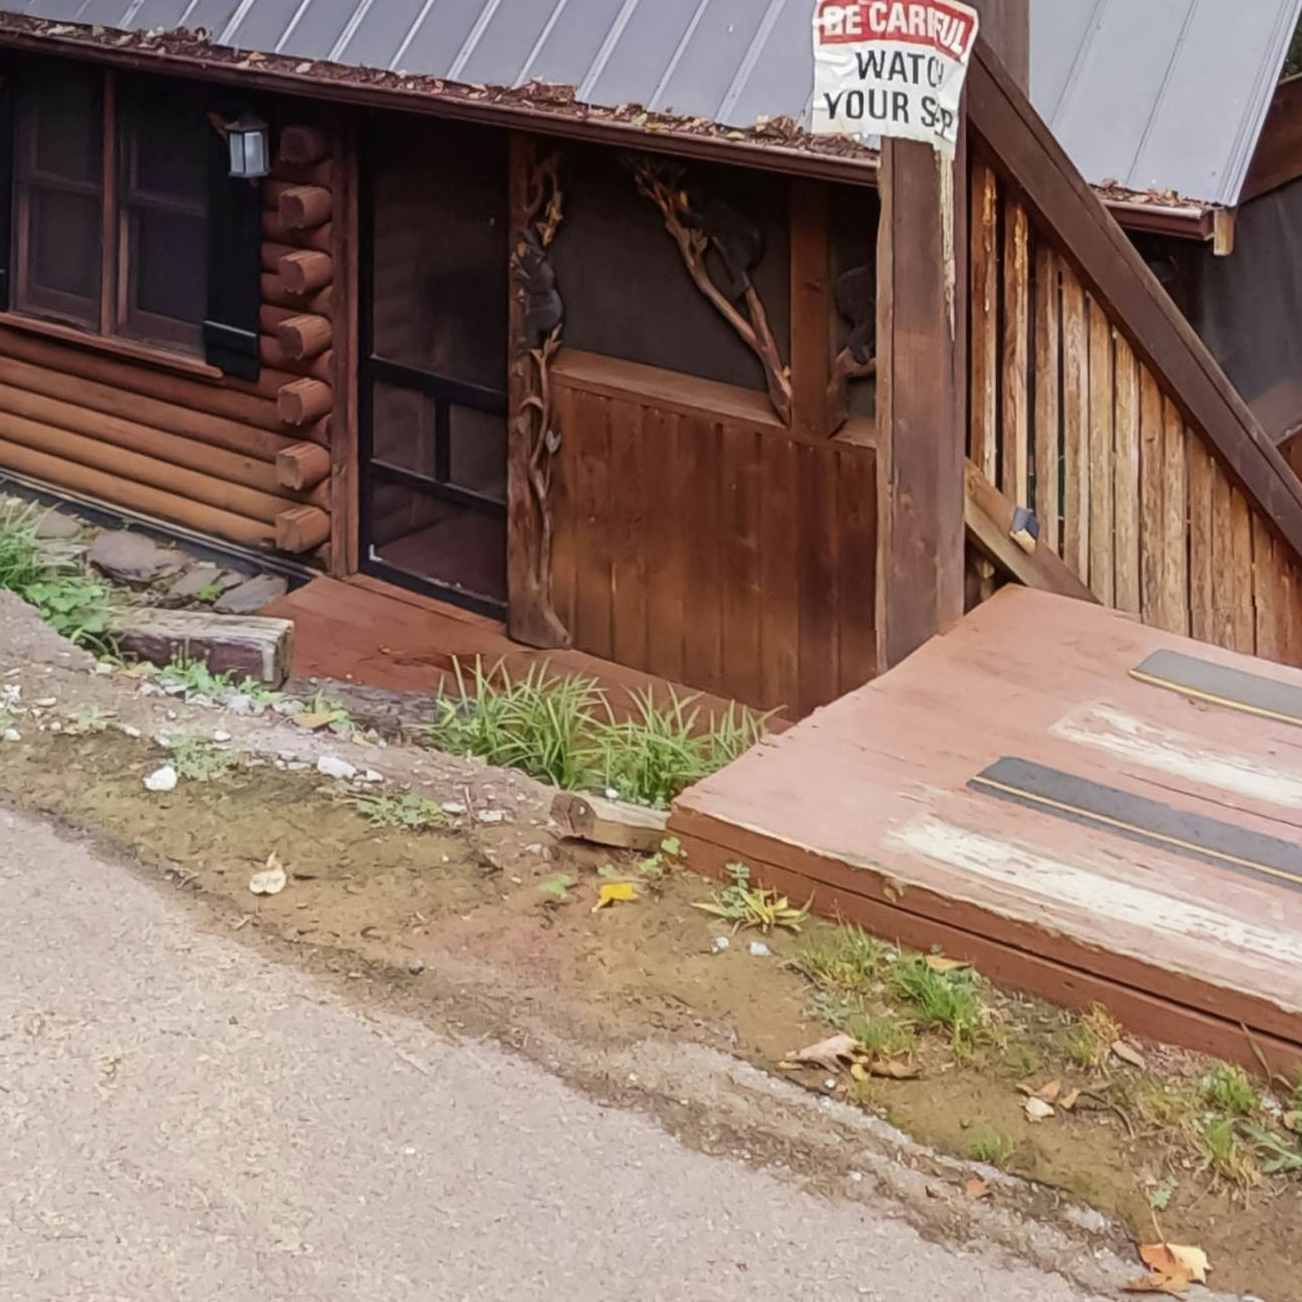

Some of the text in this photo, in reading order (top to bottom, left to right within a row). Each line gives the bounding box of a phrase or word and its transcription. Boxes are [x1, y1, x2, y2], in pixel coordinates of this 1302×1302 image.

[823, 5, 863, 36] BE
[855, 50, 944, 87] WATC
[823, 89, 953, 138] YOUR SP
